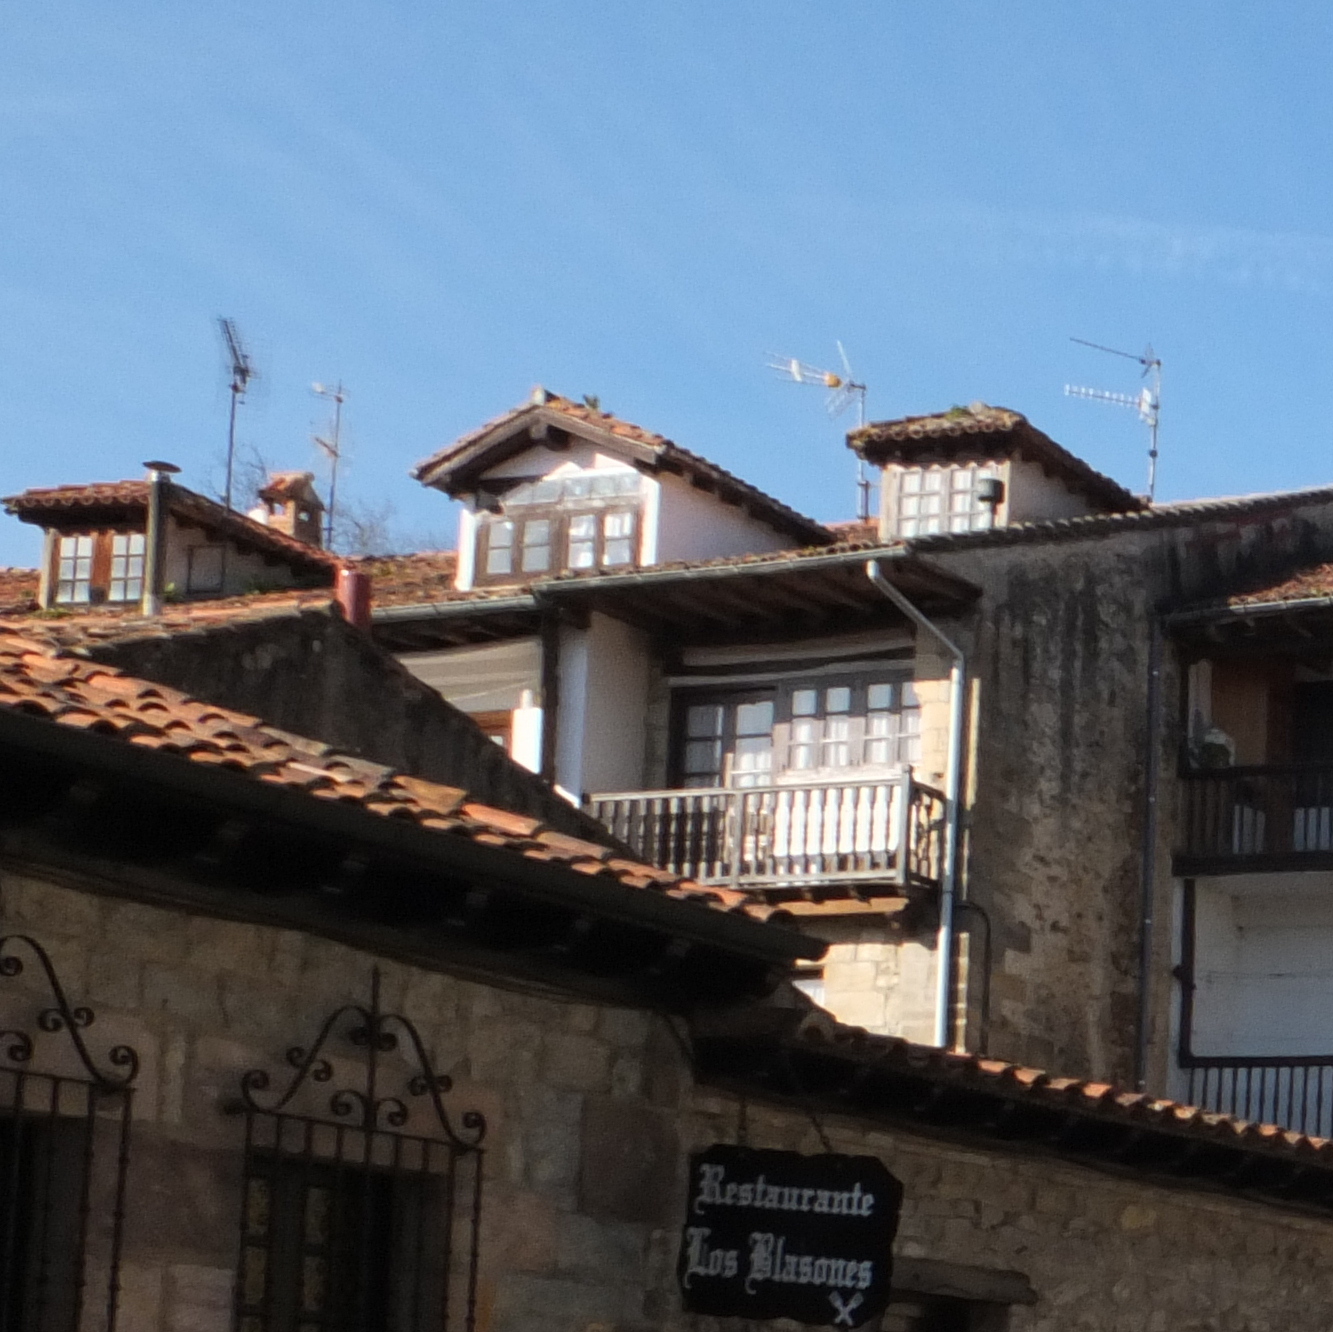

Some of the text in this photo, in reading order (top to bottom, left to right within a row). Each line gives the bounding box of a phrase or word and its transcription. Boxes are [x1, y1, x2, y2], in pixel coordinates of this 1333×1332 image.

[693, 1163, 875, 1217] Restaurante
[684, 1227, 873, 1295] Los Blasones
